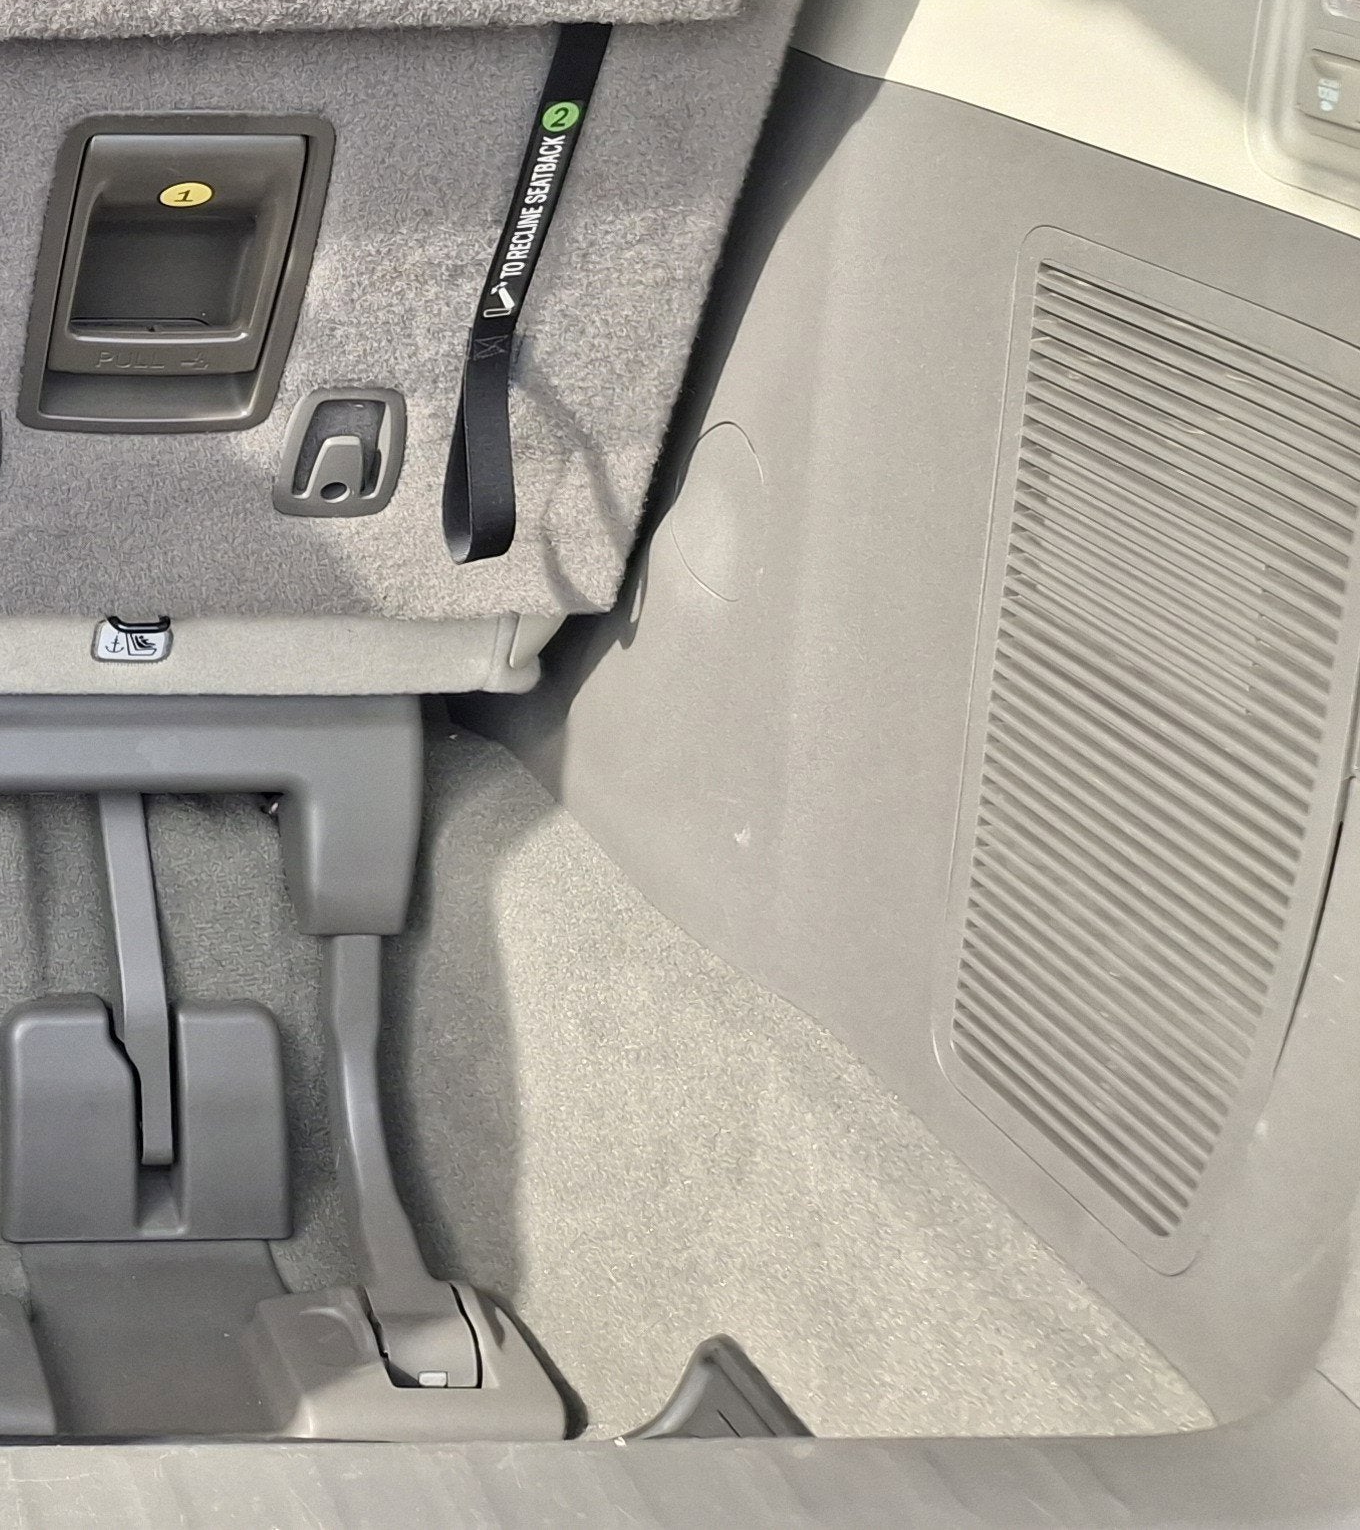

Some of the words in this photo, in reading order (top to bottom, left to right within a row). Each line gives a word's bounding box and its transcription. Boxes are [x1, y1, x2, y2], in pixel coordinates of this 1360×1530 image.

[550, 107, 569, 128] 2
[525, 135, 566, 203] SEATBACK
[174, 190, 192, 202] 1
[506, 206, 543, 260] RECLINE
[500, 262, 525, 279] TO
[95, 350, 164, 369] PULL
